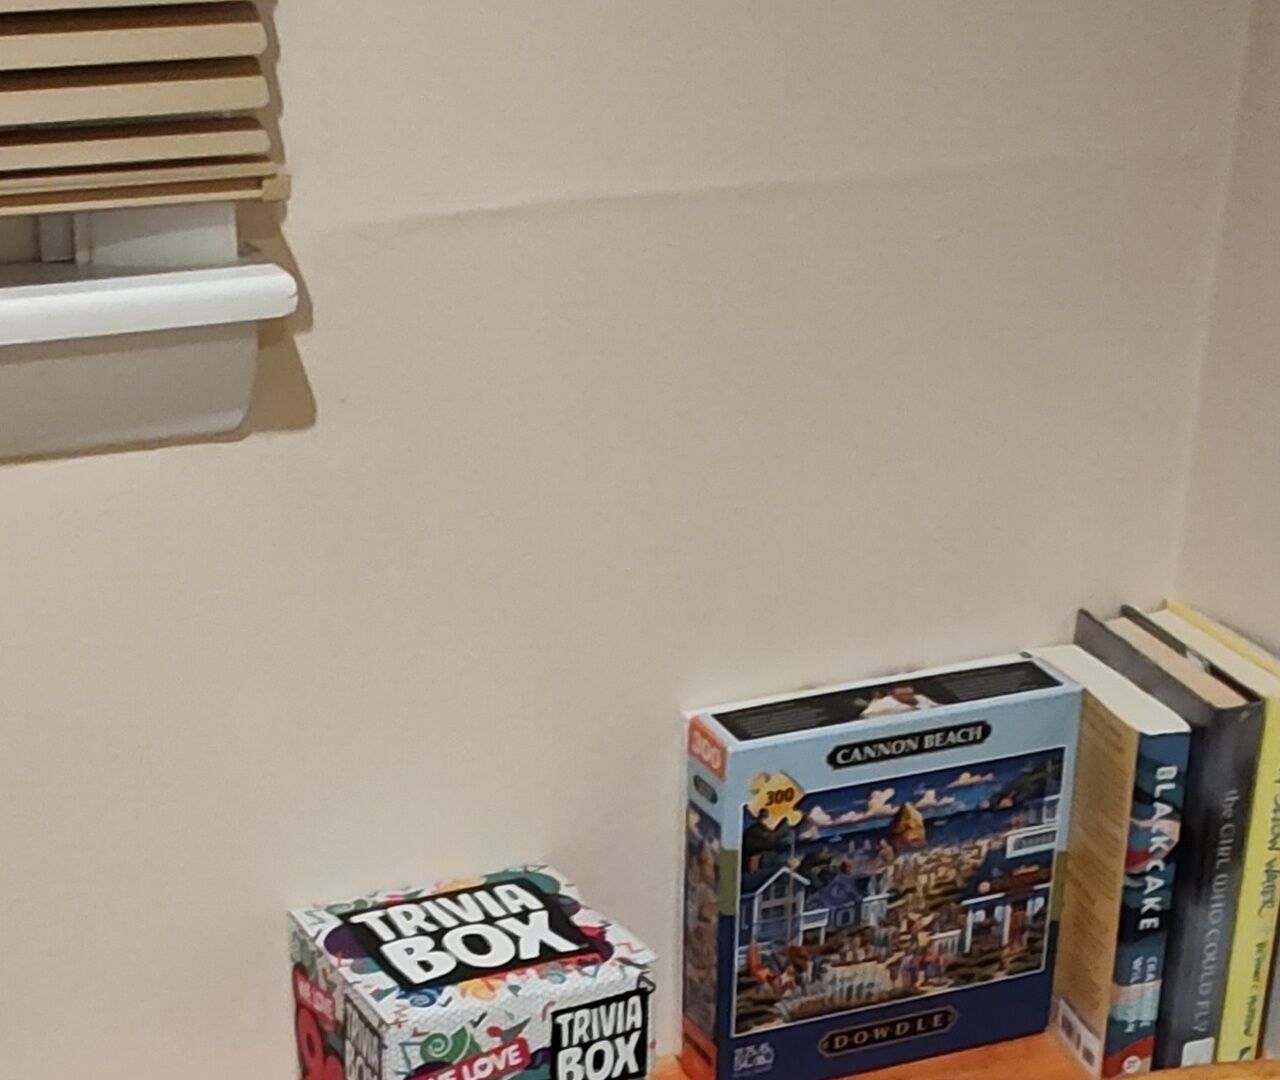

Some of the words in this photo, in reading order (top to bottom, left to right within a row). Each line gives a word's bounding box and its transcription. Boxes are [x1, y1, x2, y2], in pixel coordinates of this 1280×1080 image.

[836, 737, 919, 764] CANNON
[923, 725, 984, 751] BEACH
[765, 789, 795, 806] 300
[1222, 789, 1239, 818] the
[1216, 823, 1235, 869] GIRL
[352, 884, 544, 941] TRIVIA
[1138, 860, 1165, 930] CAKE
[1210, 874, 1229, 924] WHO
[380, 910, 579, 985] BOX
[1197, 929, 1220, 996] COULD
[556, 995, 642, 1047] TRIVIA
[833, 1013, 946, 1050] DOWDLE
